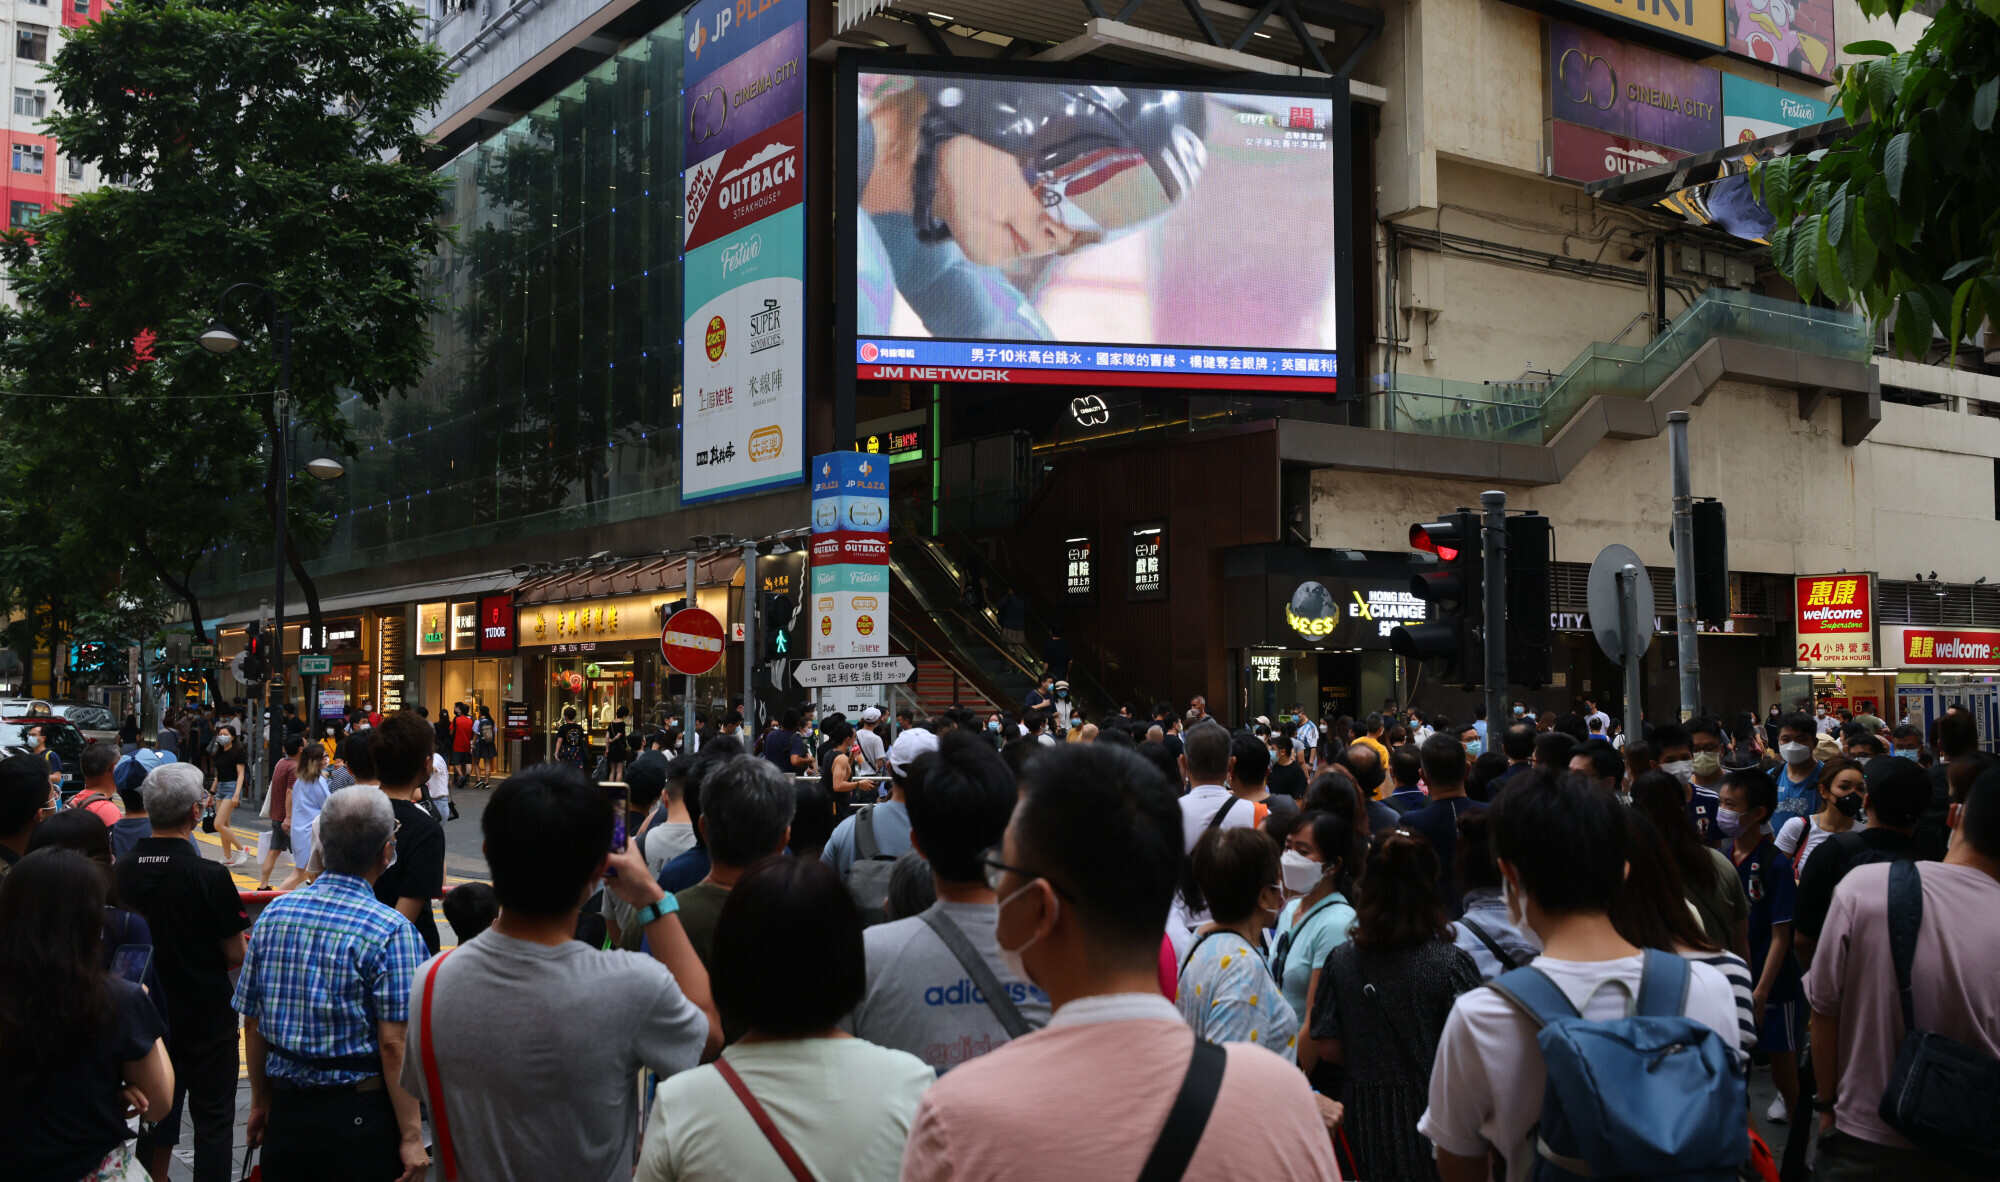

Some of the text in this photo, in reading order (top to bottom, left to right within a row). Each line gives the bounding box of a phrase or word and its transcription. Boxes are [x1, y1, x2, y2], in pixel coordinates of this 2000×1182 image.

[712, 8, 731, 42] JP
[733, 56, 799, 108] CINEMA CITY
[1626, 82, 1713, 121] CINEMA CITY
[719, 154, 796, 210] OUTBACK
[733, 191, 777, 220] STEAKHOUSE
[750, 309, 781, 337] SUPER
[873, 366, 1010, 382] JM NETWORK
[845, 480, 886, 490] JP PLAZA
[844, 543, 886, 553] OUTBACK
[1080, 549, 1089, 560] JP
[1149, 544, 1159, 556] JP
[1369, 591, 1397, 601] HONG
[1807, 580, 1858, 606] 惠康
[1349, 591, 1426, 620] EXCHANGE
[1803, 607, 1863, 620] wellcome
[1551, 613, 1584, 629] CITY
[1820, 620, 1863, 630] Superstore
[485, 627, 506, 638] TUDOR
[1799, 643, 1822, 662] 24
[1909, 636, 1934, 658] 惠康
[1936, 638, 1990, 659] wellcome
[811, 660, 898, 671] Great George Street
[1252, 656, 1280, 665] HANGE
[827, 671, 882, 683] 記利佐治街
[1257, 666, 1280, 682] 汇款
[138, 856, 170, 864] BUTTERFLY
